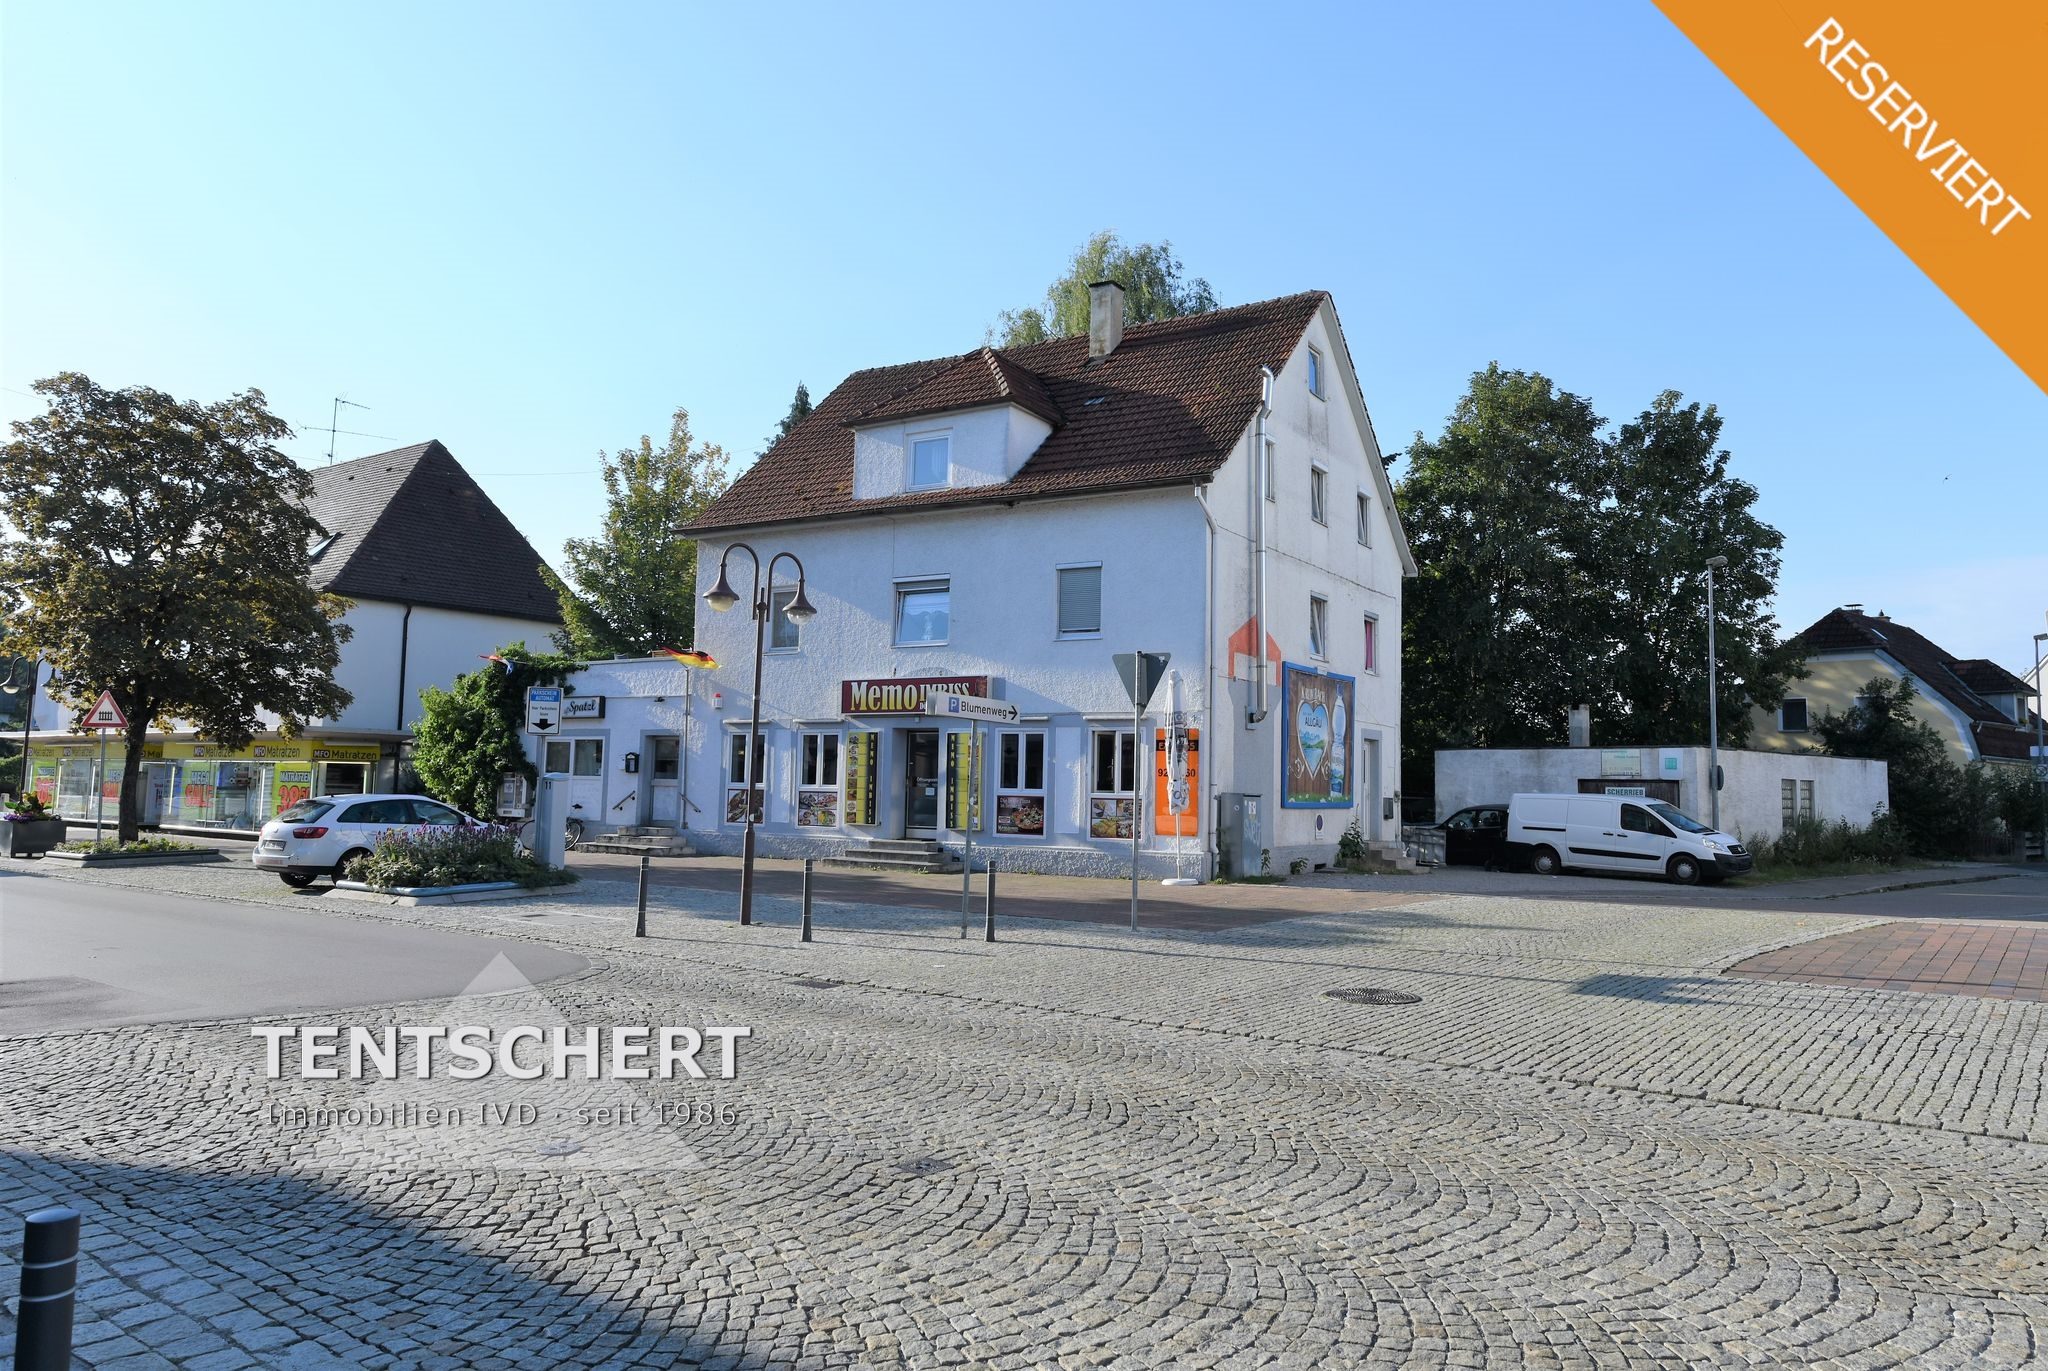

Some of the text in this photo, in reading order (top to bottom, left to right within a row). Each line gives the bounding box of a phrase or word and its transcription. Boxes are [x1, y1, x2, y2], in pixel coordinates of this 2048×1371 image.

[850, 681, 918, 711] Memo
[569, 699, 597, 715] Spatzl
[961, 700, 1008, 720] Blumenweg
[266, 746, 300, 758] Matratzen
[313, 750, 377, 760] MFO Matratzen
[280, 771, 310, 782] MATRATZEN
